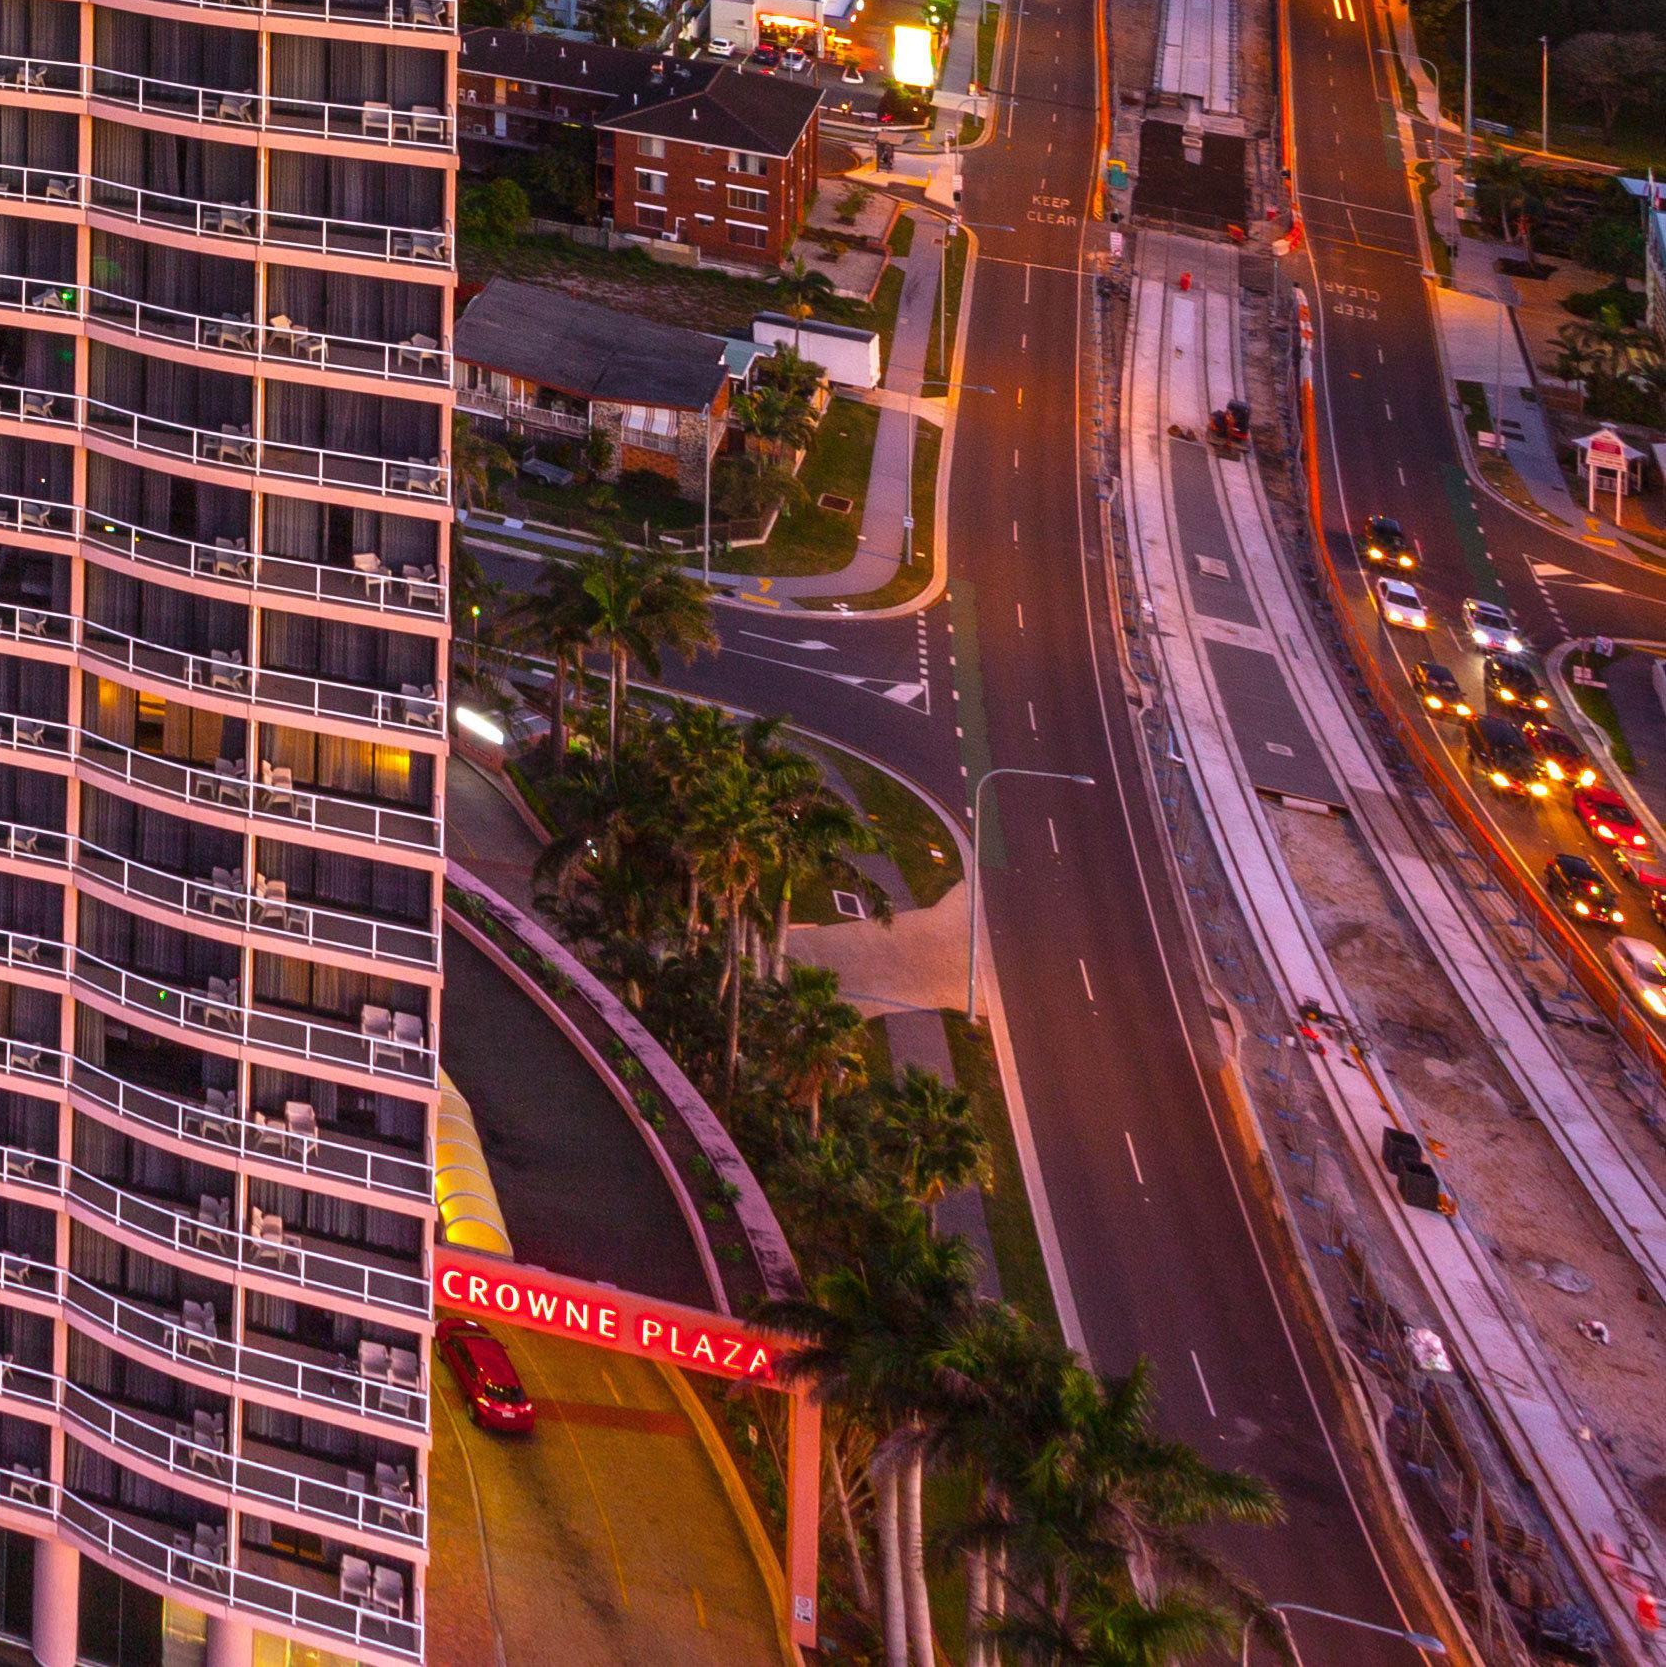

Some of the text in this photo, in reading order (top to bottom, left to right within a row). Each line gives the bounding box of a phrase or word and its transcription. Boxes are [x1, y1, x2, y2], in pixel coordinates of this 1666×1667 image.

[1032, 194, 1071, 209] KEEP
[1027, 210, 1077, 227] CLEAR
[1323, 280, 1381, 302] CLEAR
[1332, 302, 1379, 321] KEEP
[442, 1270, 774, 1380] CROWNE PLAZA
